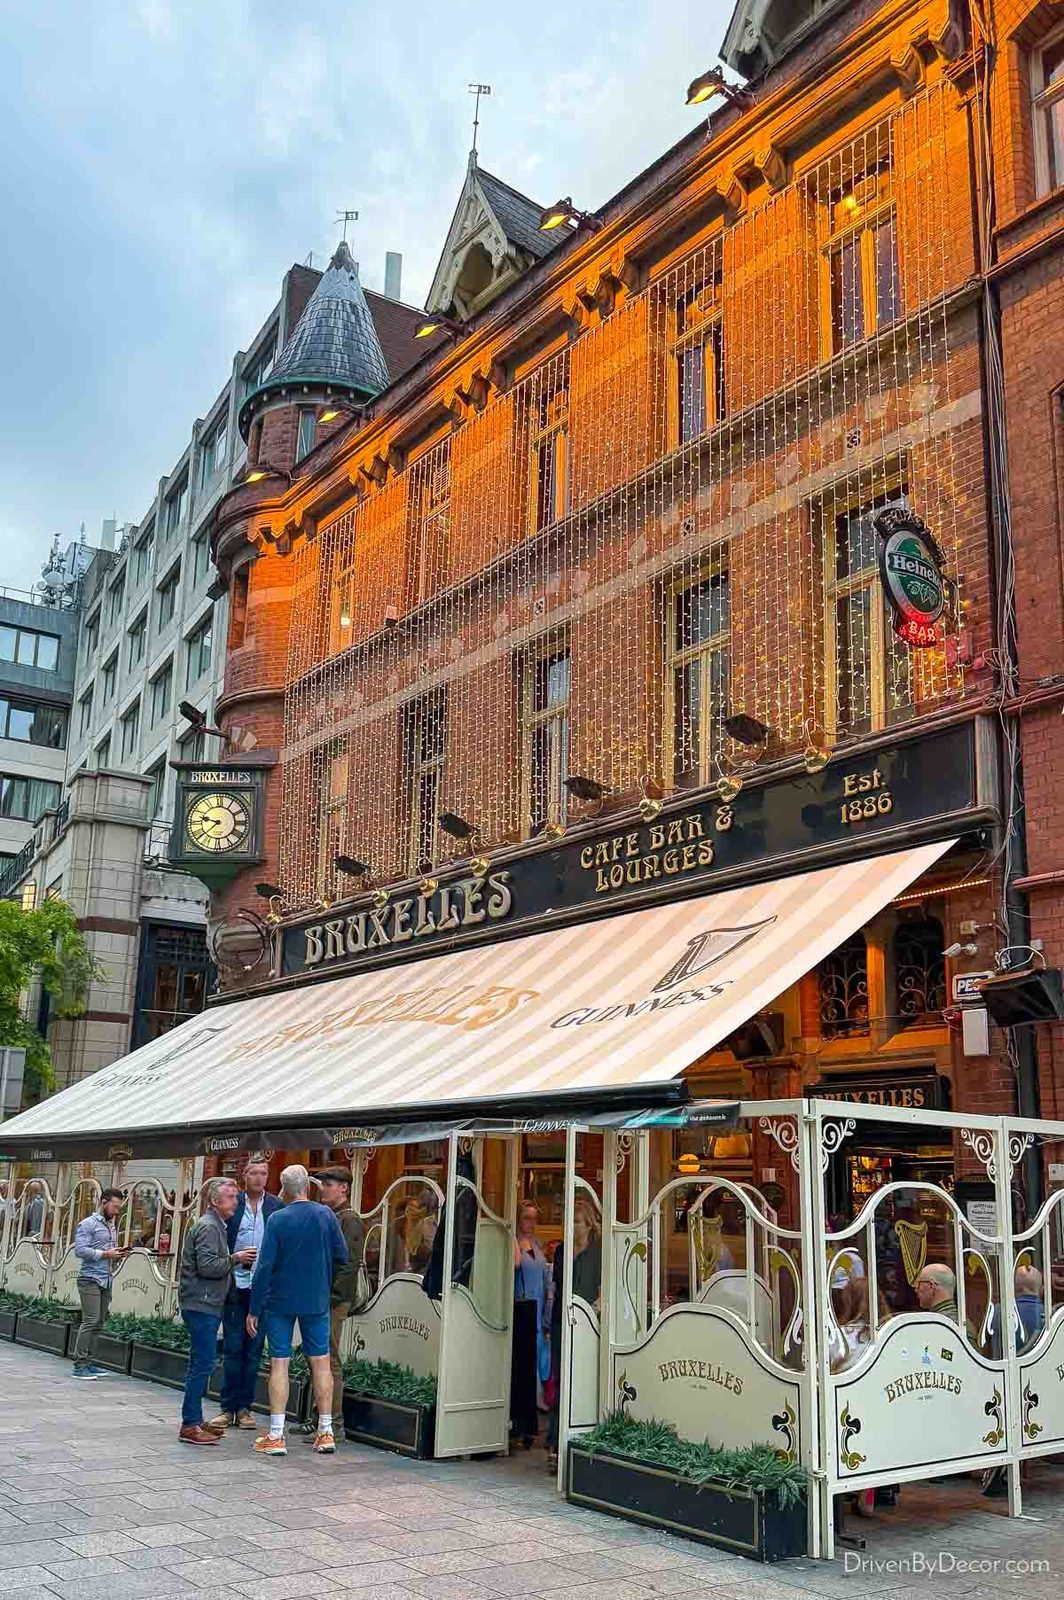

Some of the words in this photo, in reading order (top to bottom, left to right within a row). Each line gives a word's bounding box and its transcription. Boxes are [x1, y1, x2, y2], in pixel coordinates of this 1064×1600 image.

[892, 554, 944, 591] Heinek
[908, 620, 936, 642] BAR
[191, 771, 251, 783] BRUXELLES
[843, 769, 886, 797] Est.
[840, 793, 894, 824] 1886
[580, 831, 639, 869] CAFE
[649, 813, 703, 852] BAR
[715, 805, 736, 832] &
[595, 839, 716, 892] LOUNGES
[304, 872, 512, 964] BRUXELLES
[957, 978, 982, 993] PES
[550, 980, 736, 1029] GUINNESS
[813, 1087, 925, 1108] UXELLES
[210, 1136, 241, 1151] GUINNESS
[378, 1315, 431, 1341] BRUXELLES
[658, 1359, 744, 1396] BRUXELLES
[884, 1371, 963, 1403] BRUXELLES
